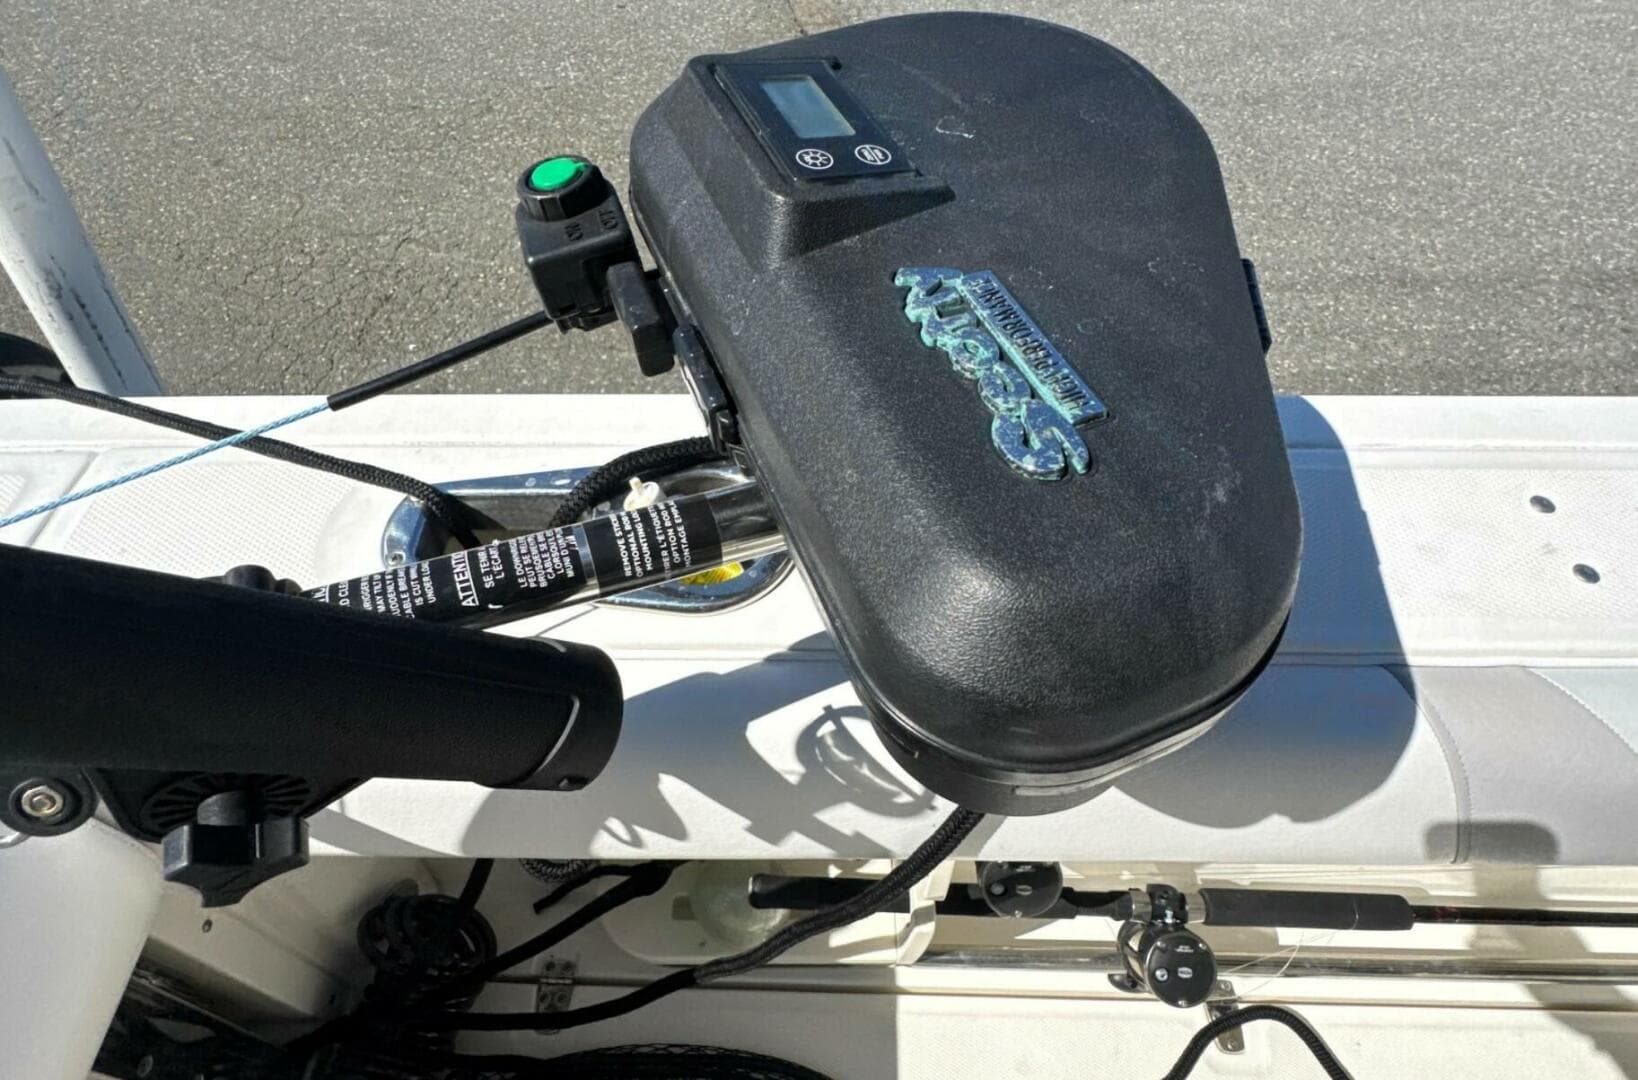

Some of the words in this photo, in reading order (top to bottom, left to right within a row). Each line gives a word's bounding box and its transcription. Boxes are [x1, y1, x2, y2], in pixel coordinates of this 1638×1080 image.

[970, 278, 1058, 380] PERFORMANCE
[1050, 368, 1089, 412] HIGH
[627, 531, 643, 577] OPTIONAL
[635, 522, 653, 571] MOUNTING
[667, 528, 680, 563] OPTION
[523, 554, 532, 569] SE
[562, 558, 575, 578] MUNI
[617, 538, 632, 577] REMOVE
[526, 570, 538, 588] PEUT
[543, 559, 556, 580] CABLE
[411, 581, 422, 596] CUT
[422, 577, 436, 603] UNDER
[482, 574, 495, 588] SE
[517, 577, 528, 588] LE
[375, 596, 386, 613] MAY
[386, 581, 401, 617] UDDENLY
[414, 597, 424, 606] IS
